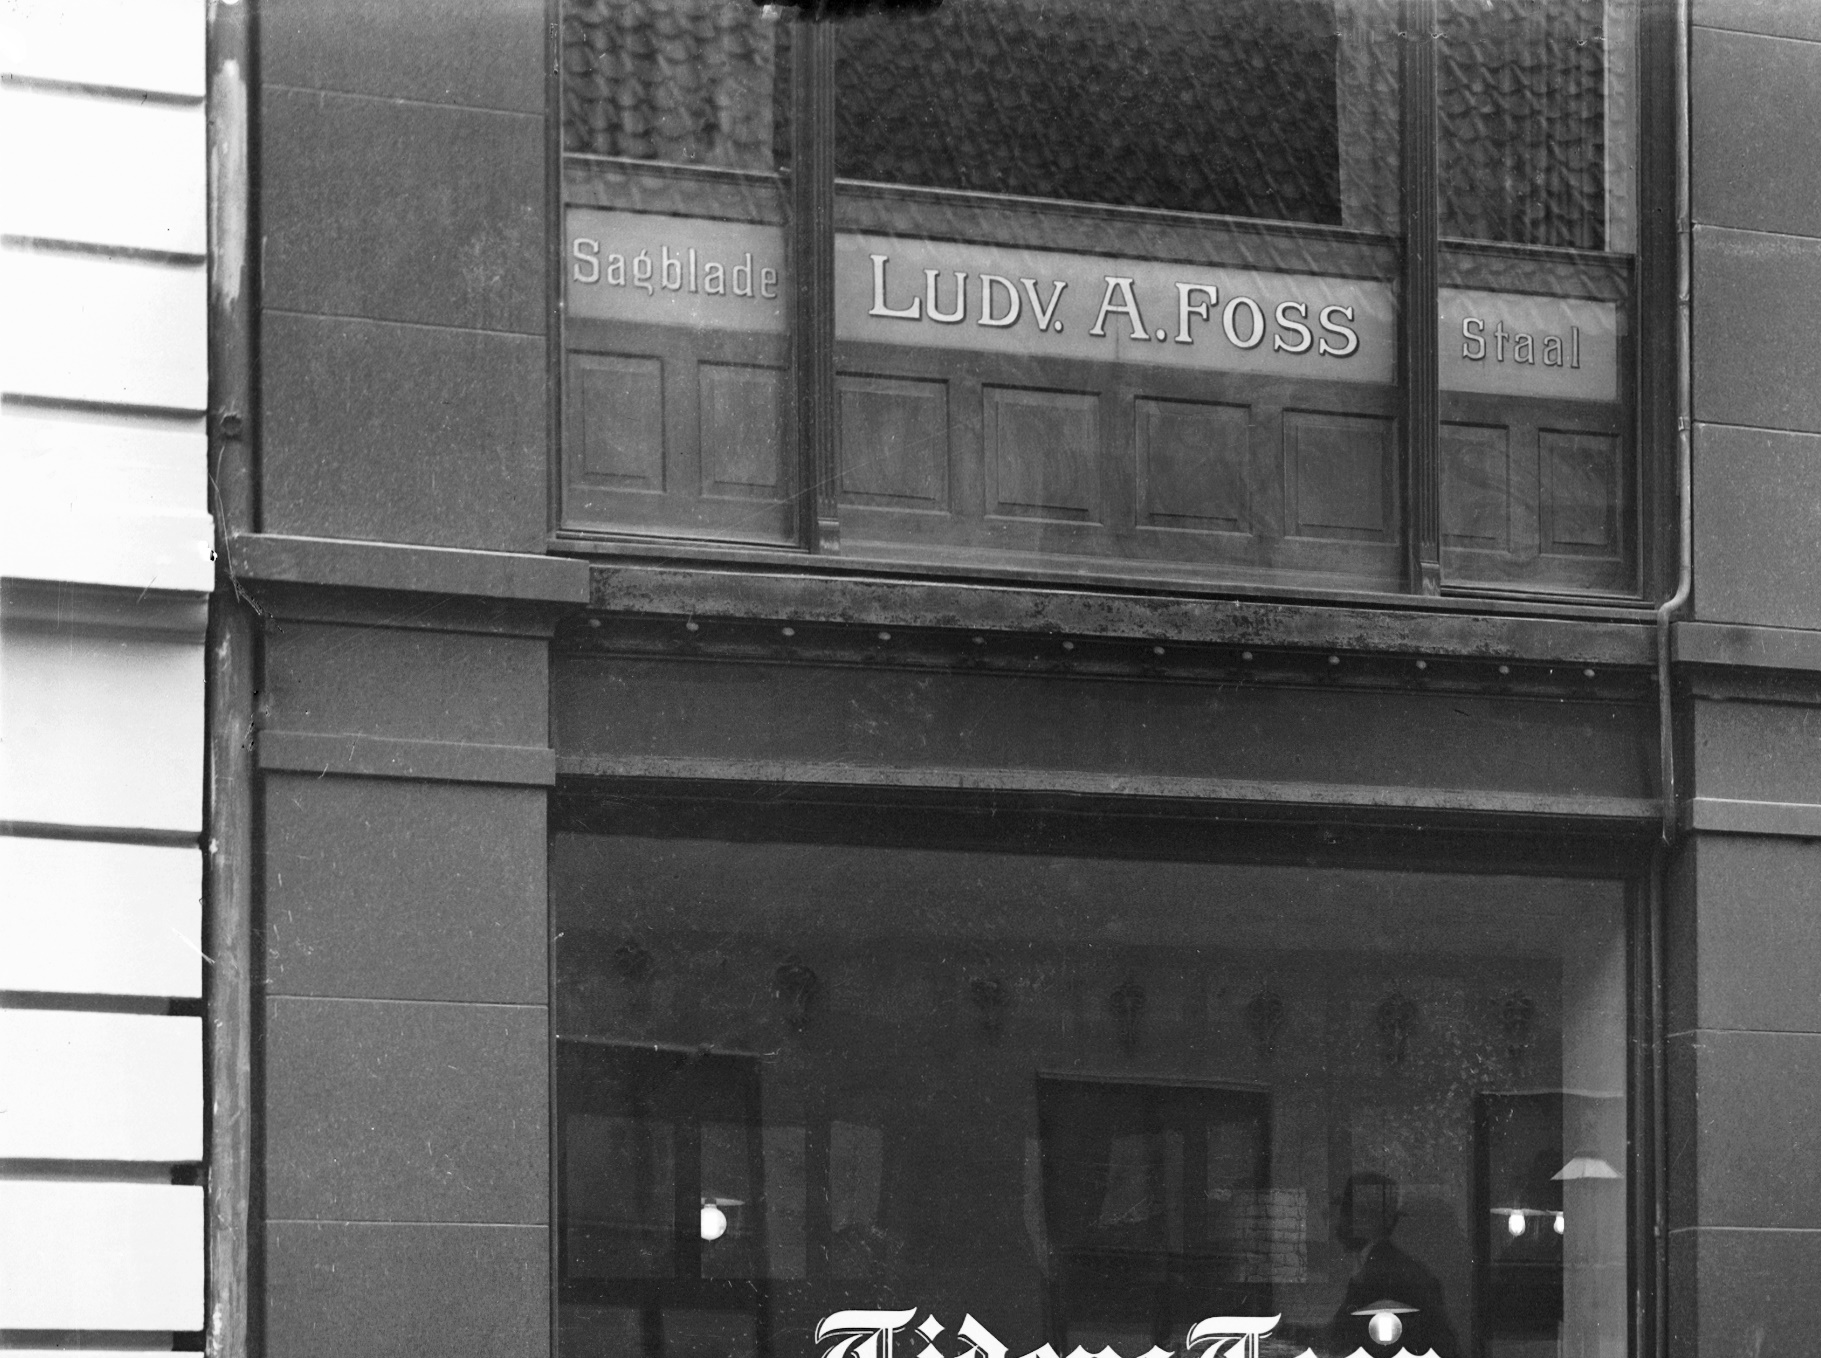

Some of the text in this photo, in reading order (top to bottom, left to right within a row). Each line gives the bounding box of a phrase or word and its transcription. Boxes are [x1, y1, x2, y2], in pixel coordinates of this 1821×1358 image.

[572, 237, 779, 300] Sagblade
[869, 254, 1067, 333] LUDV.
[1462, 317, 1581, 369] Staal
